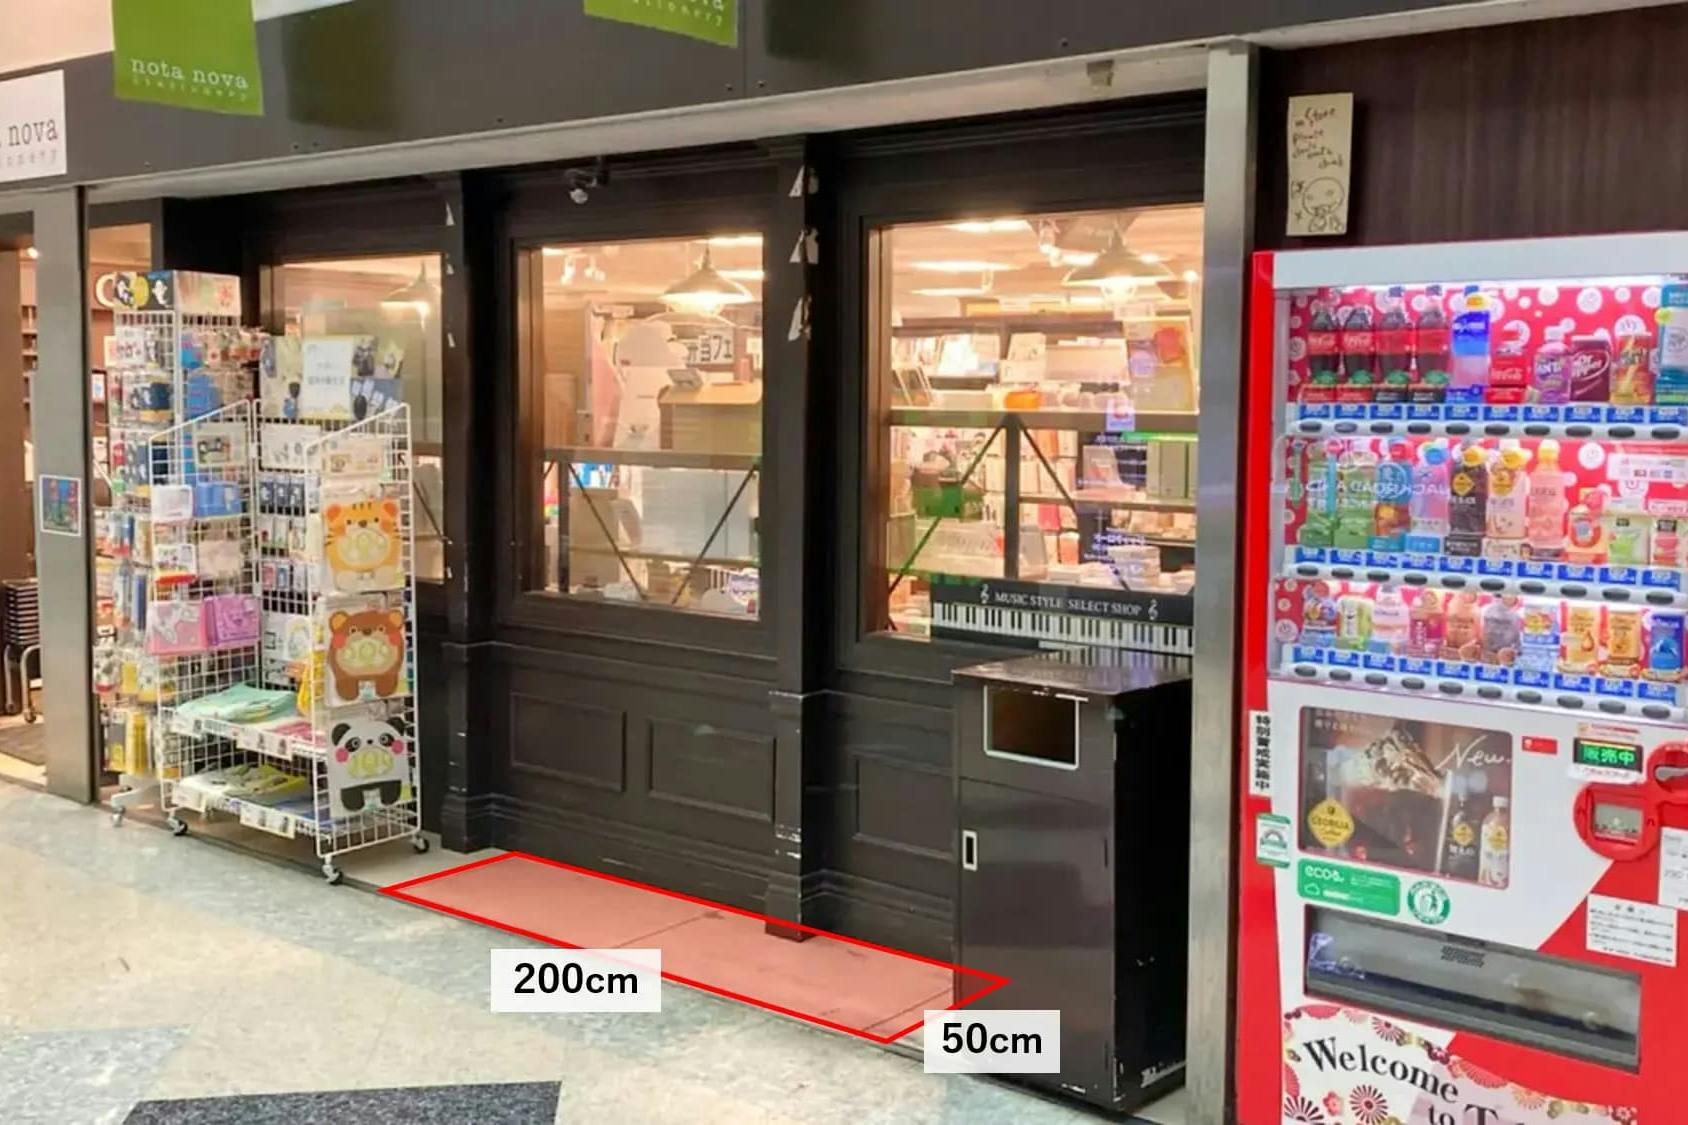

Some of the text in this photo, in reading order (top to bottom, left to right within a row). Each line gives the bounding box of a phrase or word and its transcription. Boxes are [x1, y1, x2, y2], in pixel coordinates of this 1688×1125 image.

[131, 58, 249, 89] nota nova
[8, 118, 58, 147] nova
[994, 591, 1143, 616] MUSIC STYLE SELECT SHOP
[1302, 1036, 1459, 1104] Welcome
